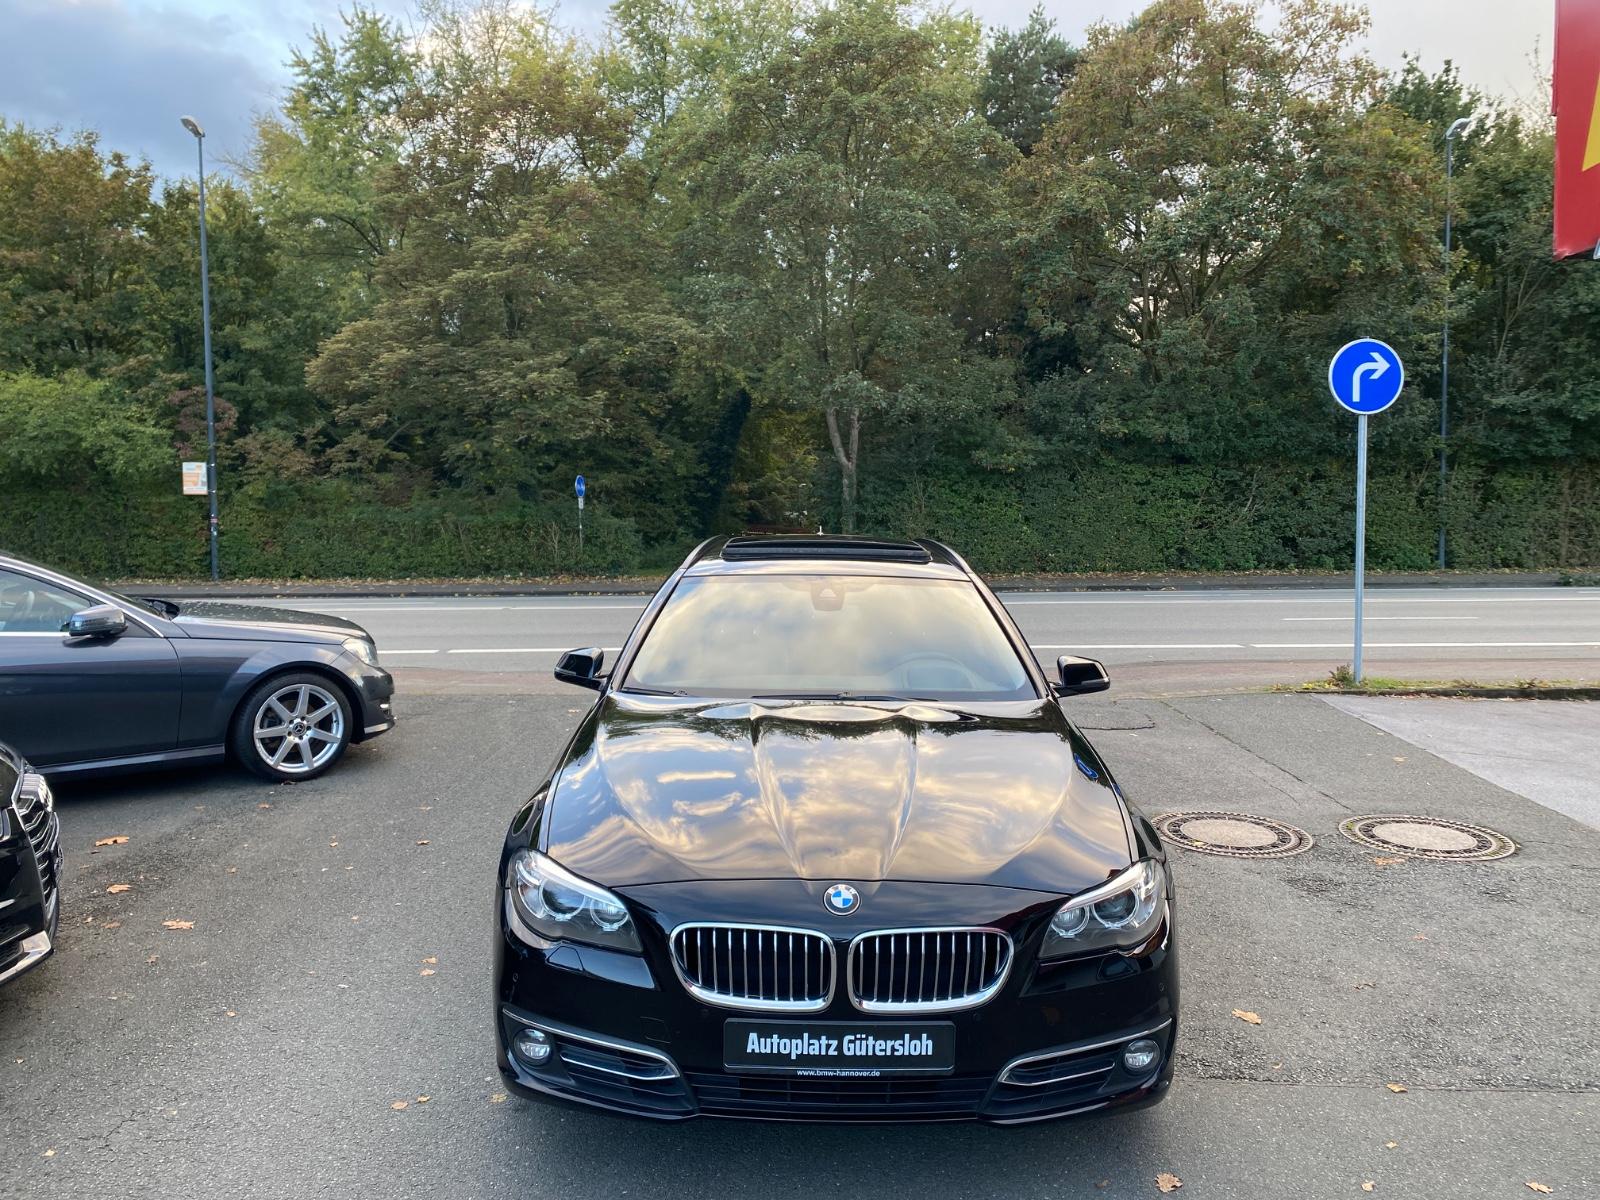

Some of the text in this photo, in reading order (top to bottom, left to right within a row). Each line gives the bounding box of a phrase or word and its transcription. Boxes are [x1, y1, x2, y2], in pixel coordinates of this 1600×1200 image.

[746, 1032, 933, 1059] Autoplatz Gütersloh
[796, 1069, 881, 1078] www.bmw-hannover.de
